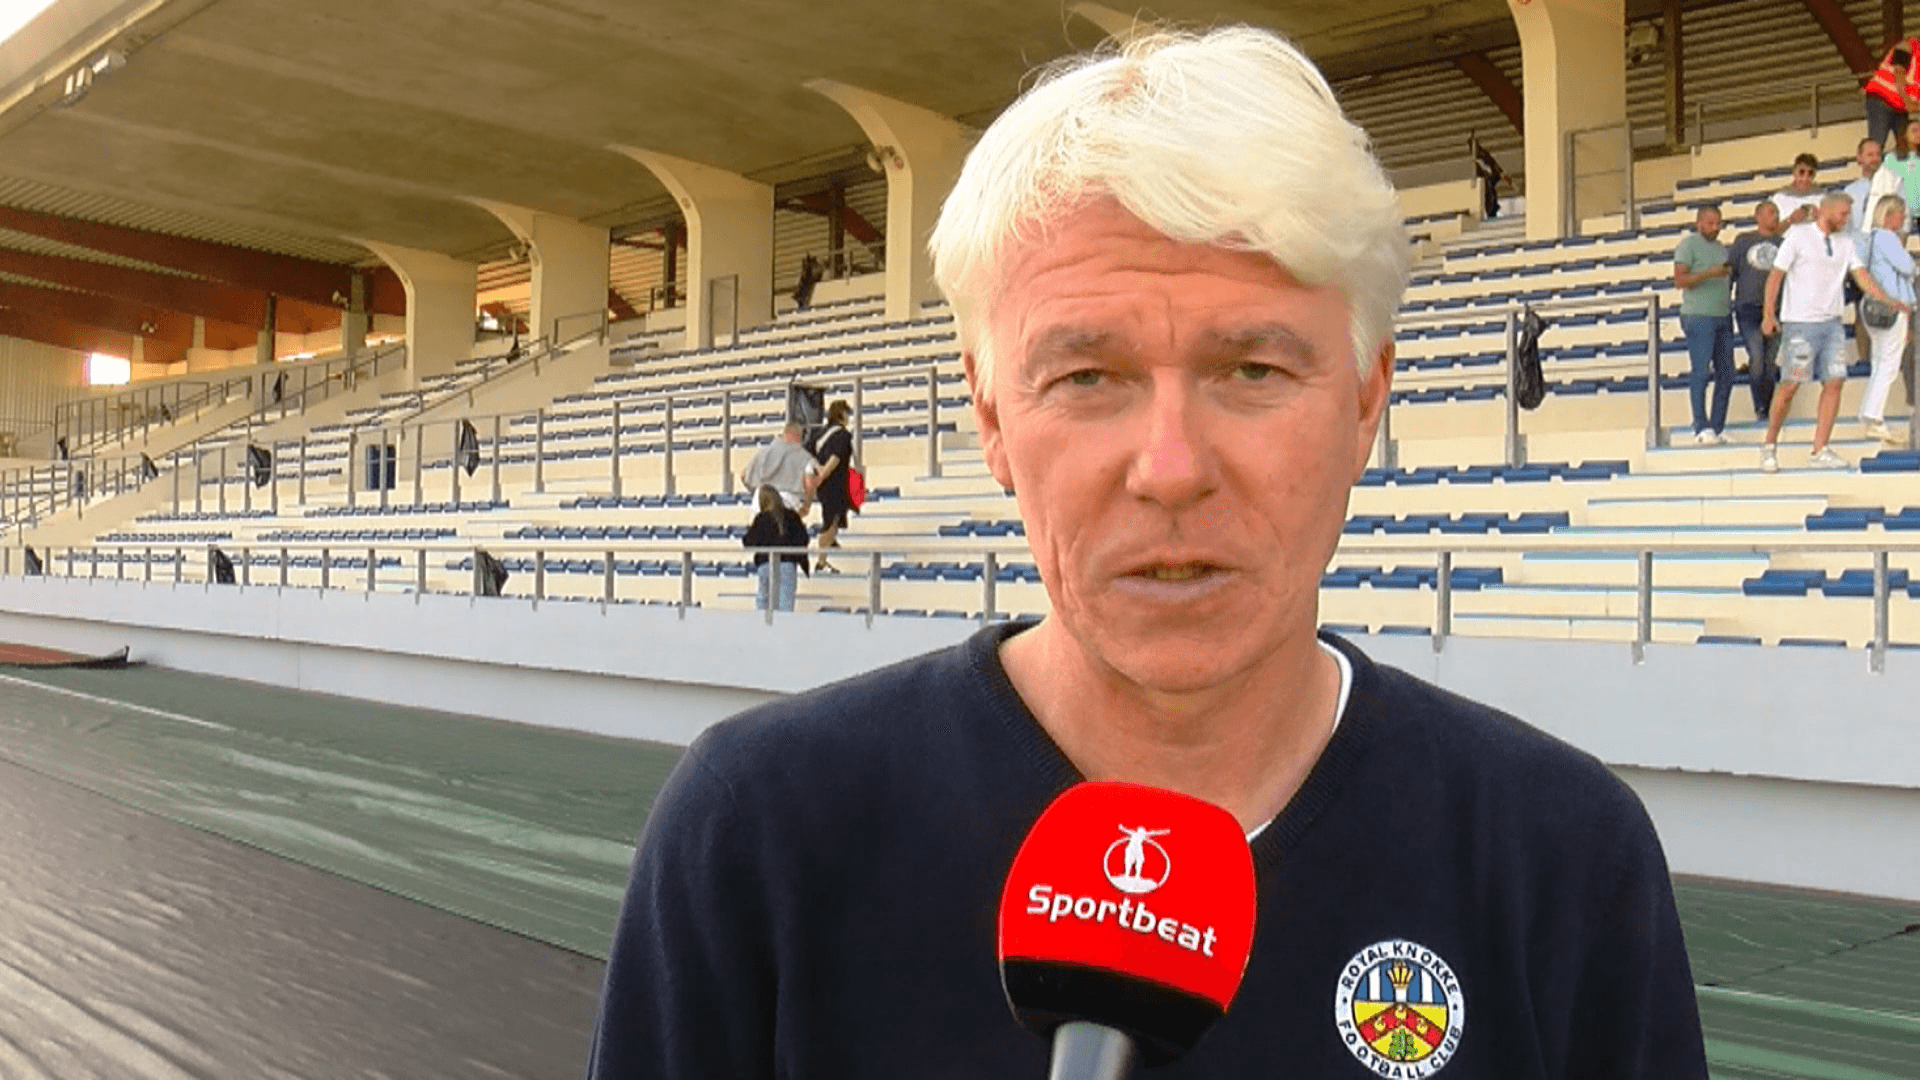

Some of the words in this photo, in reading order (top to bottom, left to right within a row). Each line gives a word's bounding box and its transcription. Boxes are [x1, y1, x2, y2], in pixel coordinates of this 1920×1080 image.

[1026, 883, 1217, 957] Sportbeat
[1341, 945, 1388, 989] ROYAL
[1393, 943, 1458, 994] KNOKKE
[1339, 1019, 1425, 1079] FOOTBALL
[1430, 1026, 1461, 1069] CLUB
